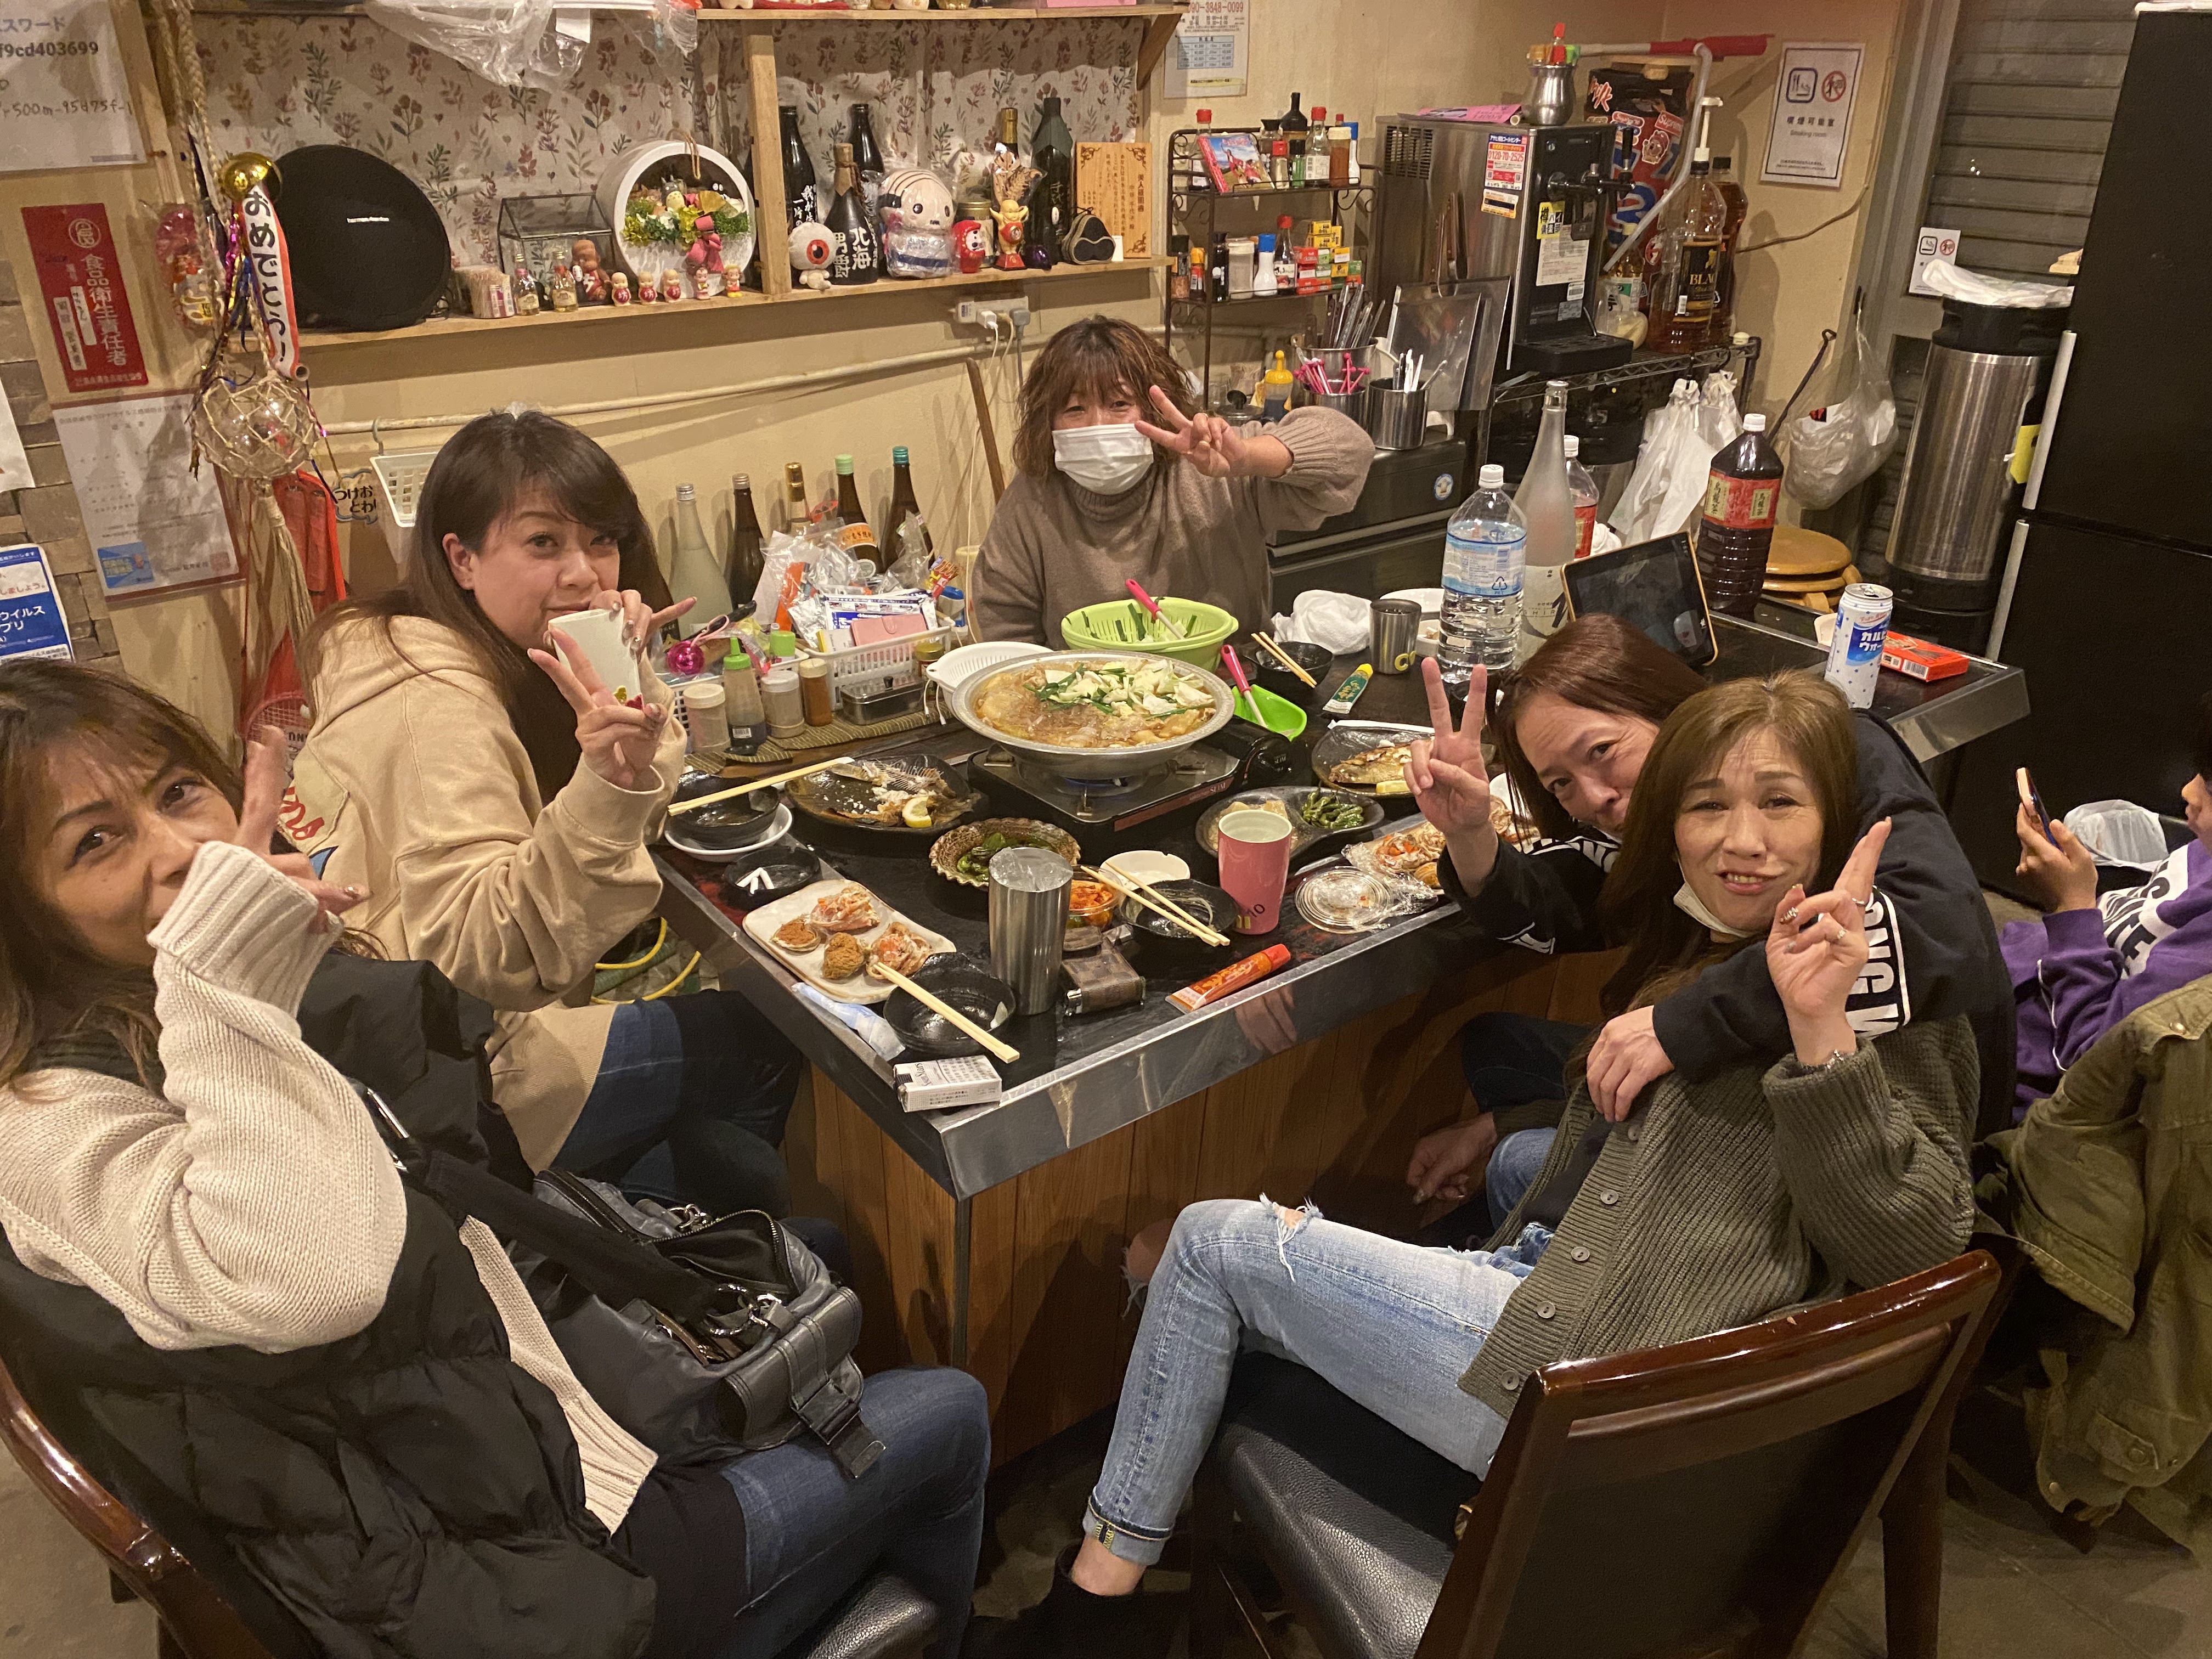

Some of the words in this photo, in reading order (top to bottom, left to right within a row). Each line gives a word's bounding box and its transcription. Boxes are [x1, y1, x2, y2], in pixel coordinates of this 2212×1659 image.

[0, 16, 65, 32] スワード
[1488, 151, 1524, 162] 0120-70-2525
[849, 226, 873, 270] 北海
[80, 253, 127, 366] 食品衛生責任者
[1210, 782, 1226, 793] SLIM
[1247, 904, 1265, 917] 10
